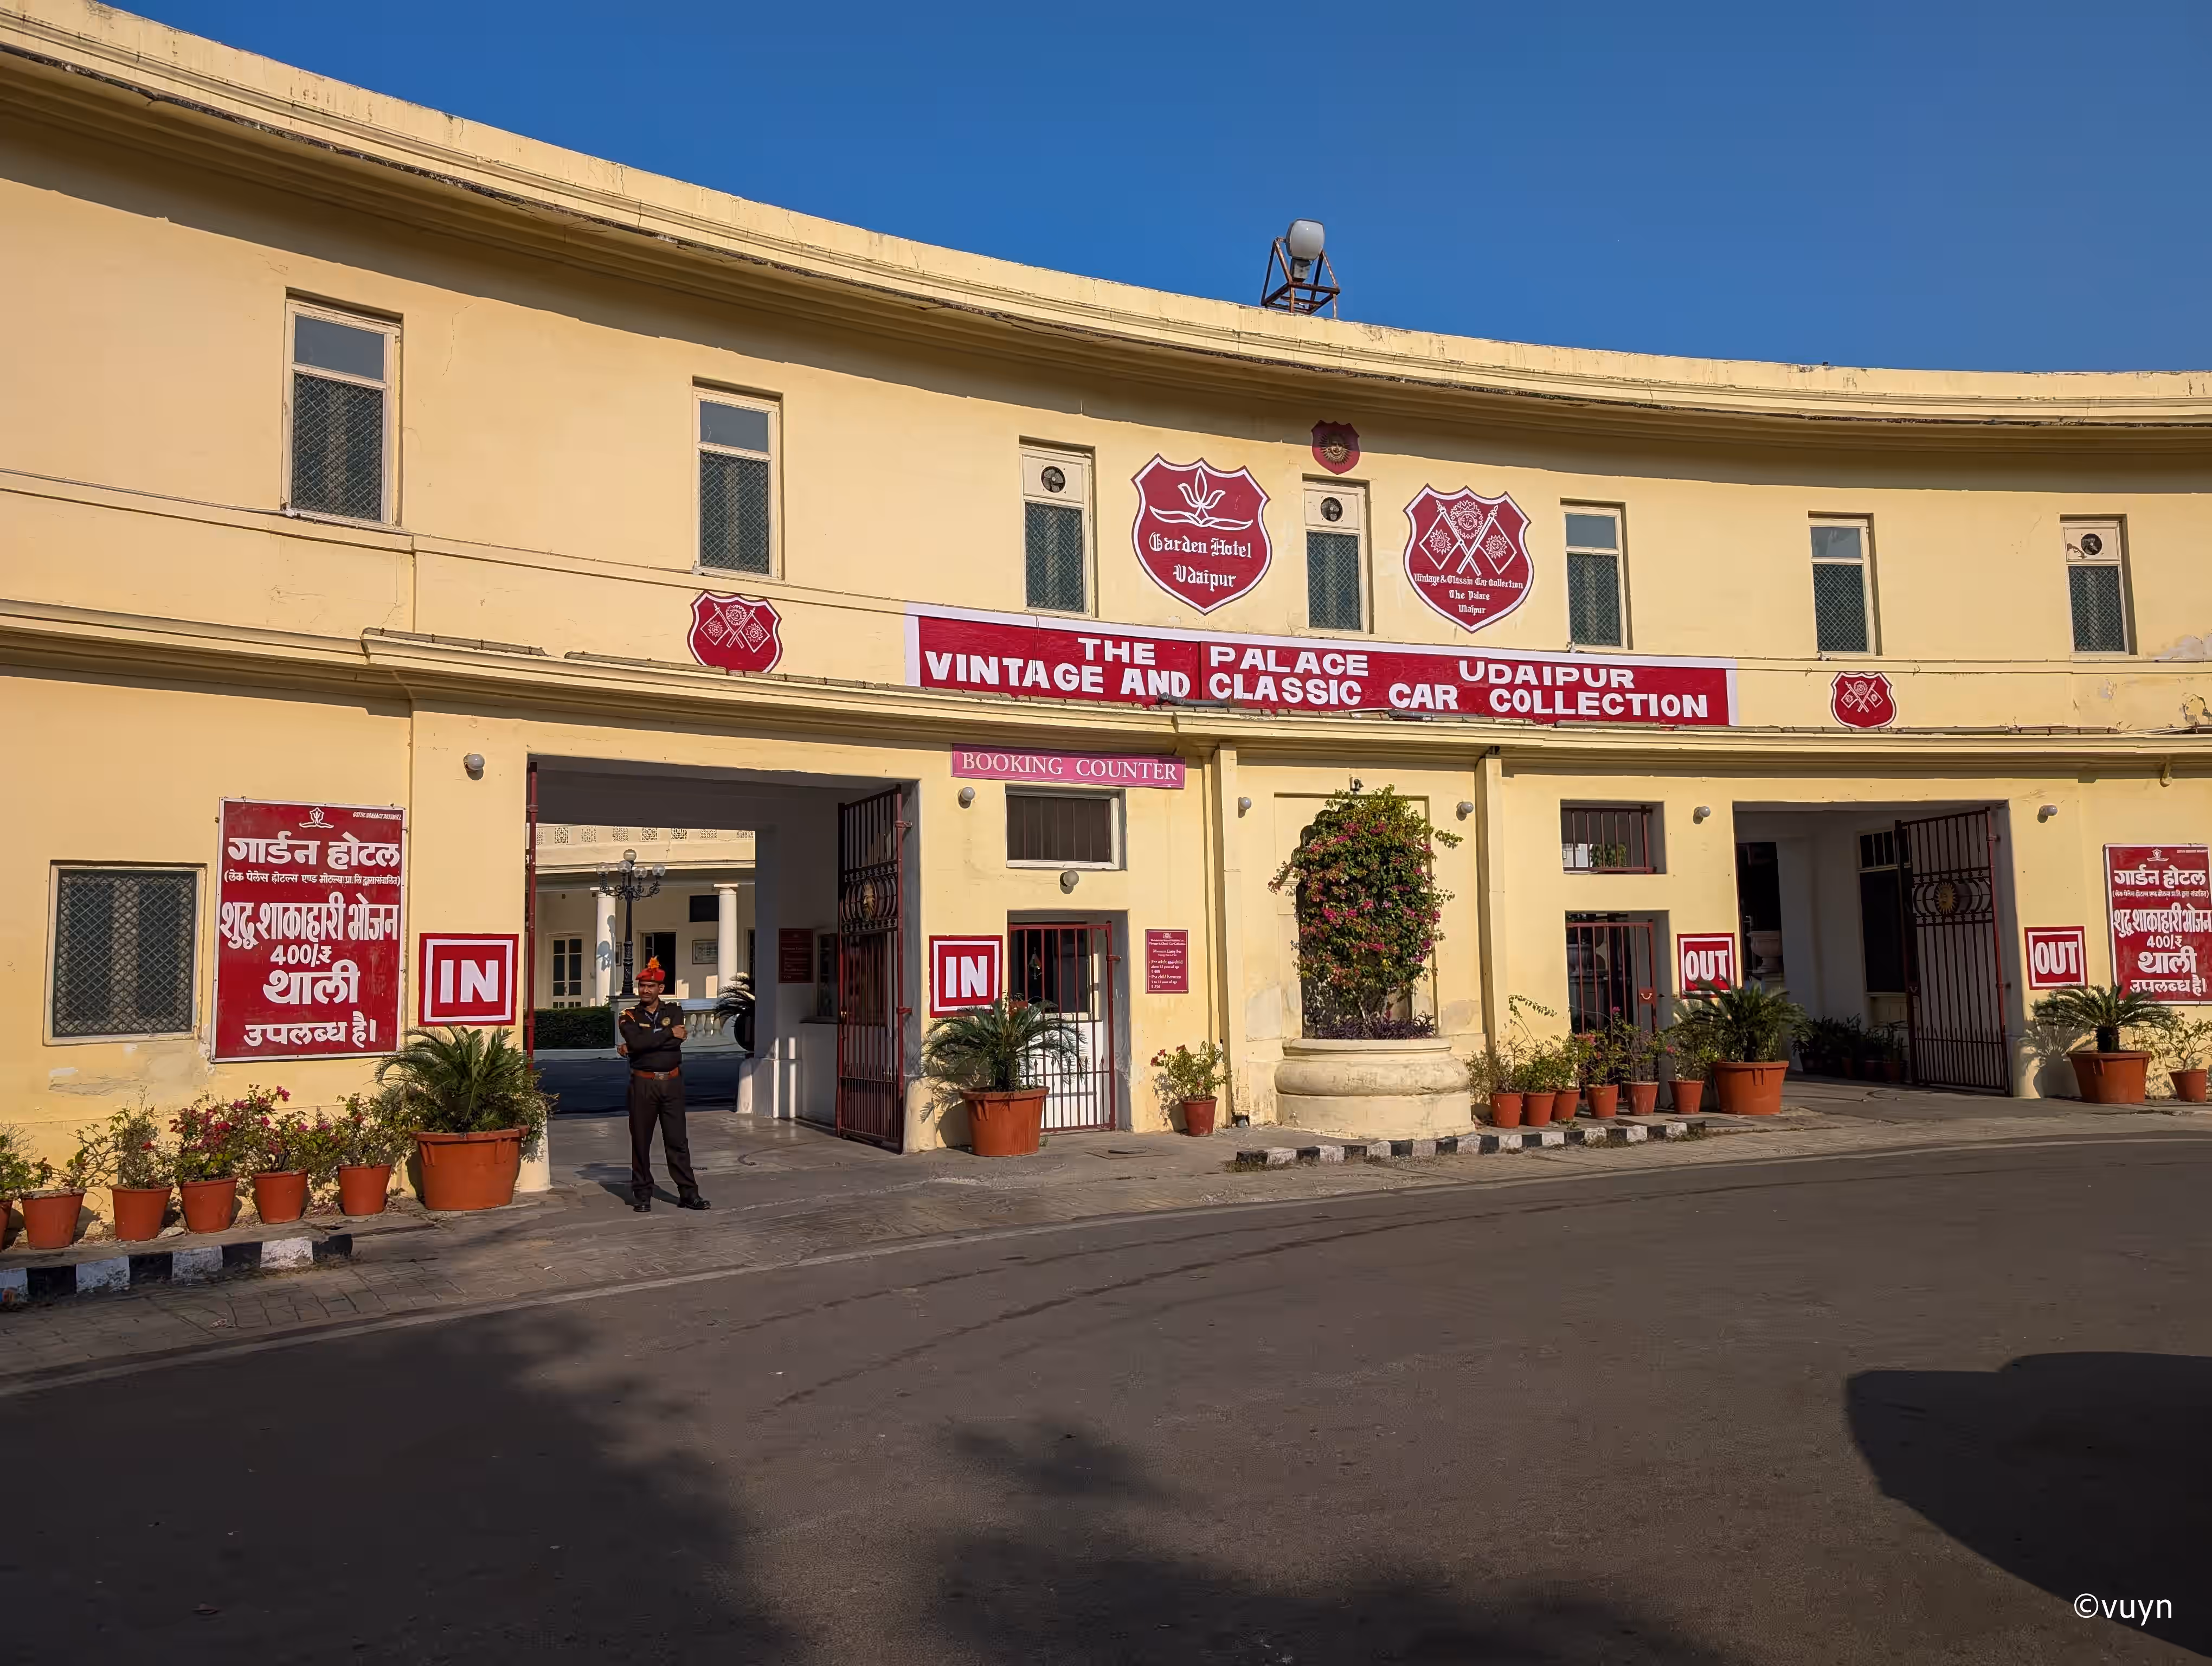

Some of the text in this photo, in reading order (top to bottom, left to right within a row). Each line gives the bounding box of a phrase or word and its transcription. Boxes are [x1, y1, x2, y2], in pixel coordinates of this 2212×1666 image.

[1149, 532, 1252, 558] Garden Hotel
[1173, 564, 1236, 592] Udaipur
[1440, 575, 1446, 583] &
[1475, 578, 1488, 586] Car
[1449, 589, 1465, 599] The
[1078, 638, 1634, 689] THE PALACE UDAIPUR
[925, 651, 1708, 717] VINTAGE AND CLASSIC CAR COLLECTION
[962, 752, 1177, 781] BOOKING COUNTER
[228, 830, 400, 870] गार्डन होटल
[2114, 864, 2206, 888] गार्डन होटल
[256, 891, 346, 943] शाकाहारी
[348, 892, 399, 941] भोजन
[2132, 902, 2182, 933] शाकाहारी
[2182, 903, 2212, 932] भोजन
[1686, 950, 1728, 981] OUT
[2035, 941, 2078, 974] OUT
[2138, 945, 2197, 973] थाली
[263, 959, 360, 1004] थाली
[427, 960, 499, 1003] IN
[946, 956, 987, 998] IN
[2130, 979, 2190, 994] उपलब्ध
[243, 1021, 348, 1047] उपलब्ध
